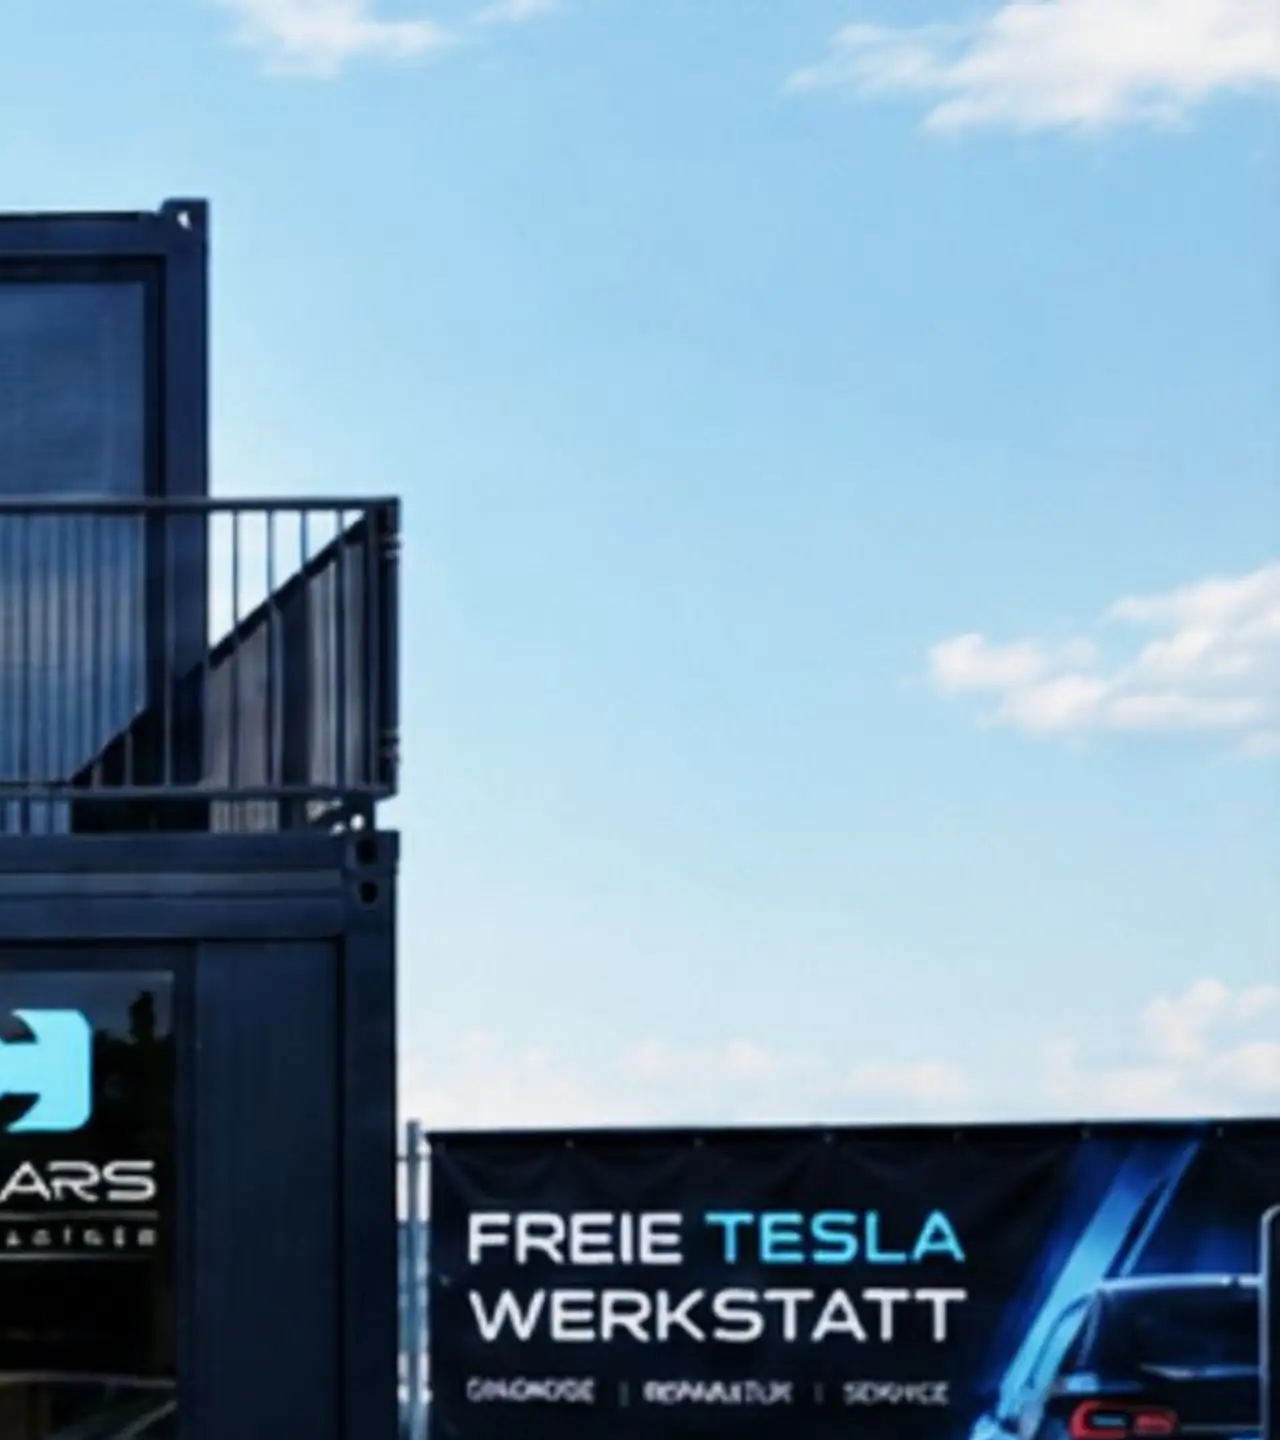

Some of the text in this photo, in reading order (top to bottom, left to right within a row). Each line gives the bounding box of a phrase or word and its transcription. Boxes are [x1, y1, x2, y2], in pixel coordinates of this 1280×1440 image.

[468, 1210, 965, 1265] FREIE TESLA
[469, 1287, 967, 1342] WERKSTATT
